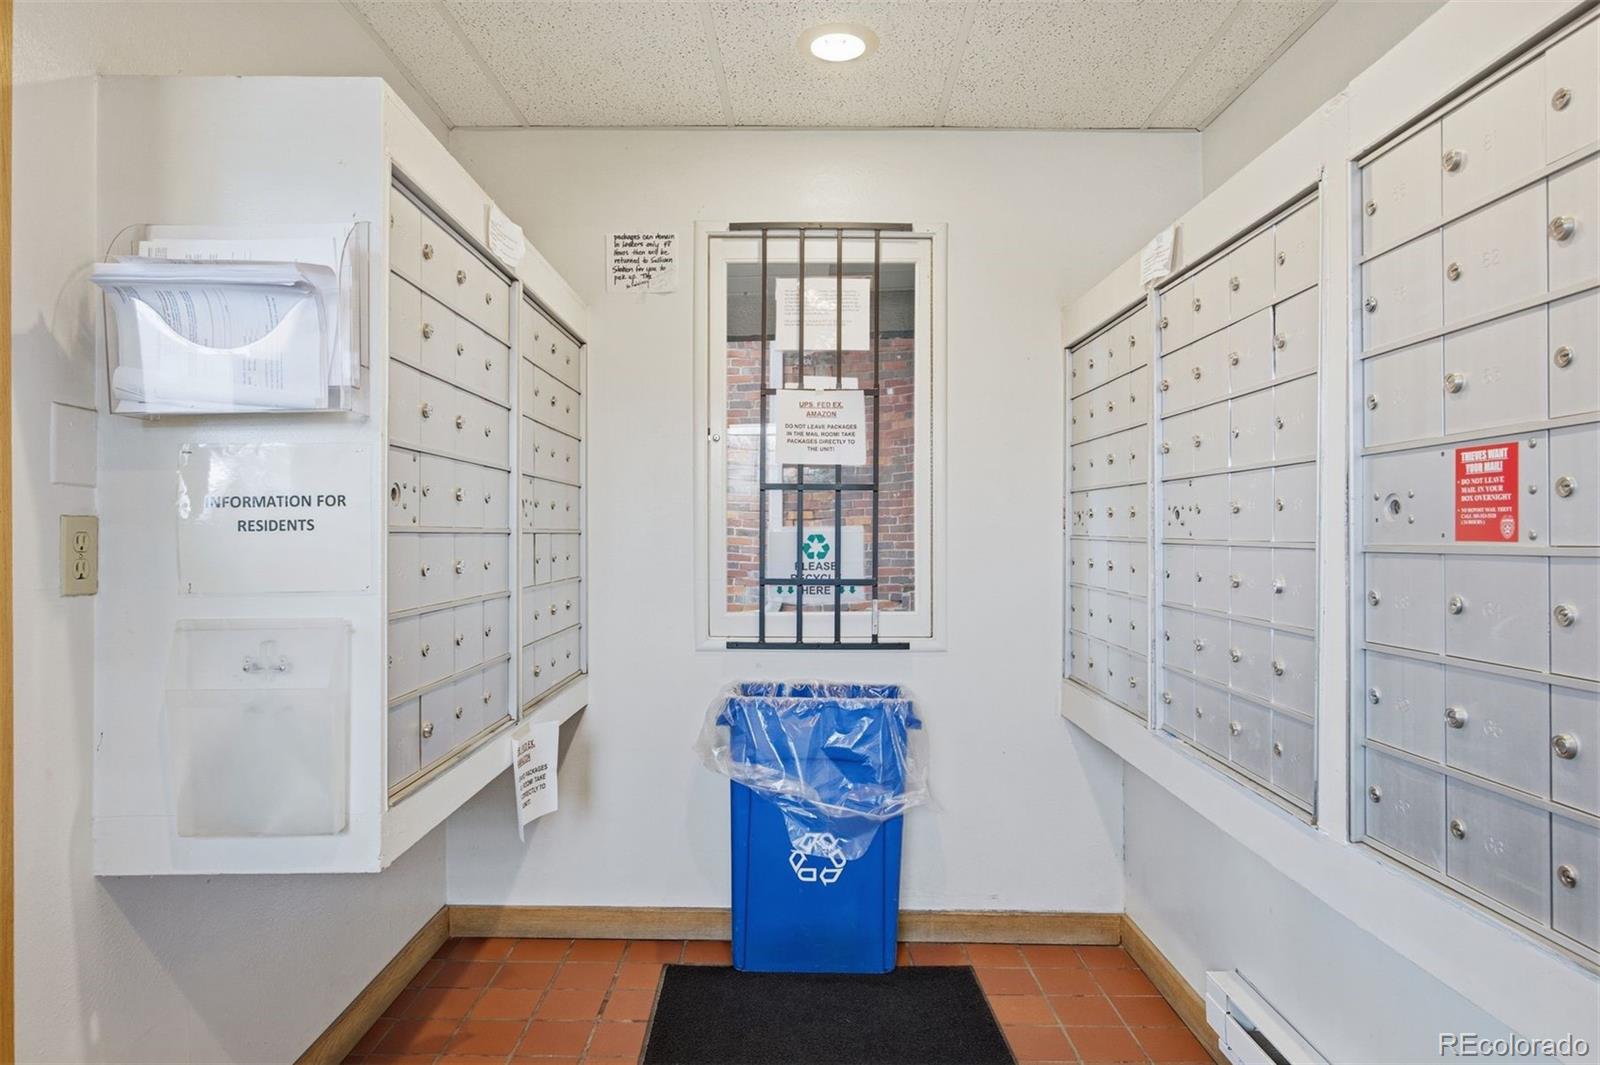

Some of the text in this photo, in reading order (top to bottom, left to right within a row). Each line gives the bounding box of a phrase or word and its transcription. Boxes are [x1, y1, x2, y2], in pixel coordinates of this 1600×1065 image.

[805, 410, 837, 418] AMAZON
[1460, 447, 1509, 463] THIEVES WANT
[1465, 462, 1483, 475] YOUR
[1460, 475, 1505, 486] DO NOT LEAVE
[1461, 486, 1477, 494] MAIL
[1485, 484, 1504, 492] YOUR
[204, 494, 347, 509] INFORMATION FOR
[1461, 493, 1512, 502] BOX OVERNIGHT
[237, 518, 315, 532] RESIDENTS
[801, 585, 831, 595] HERE
